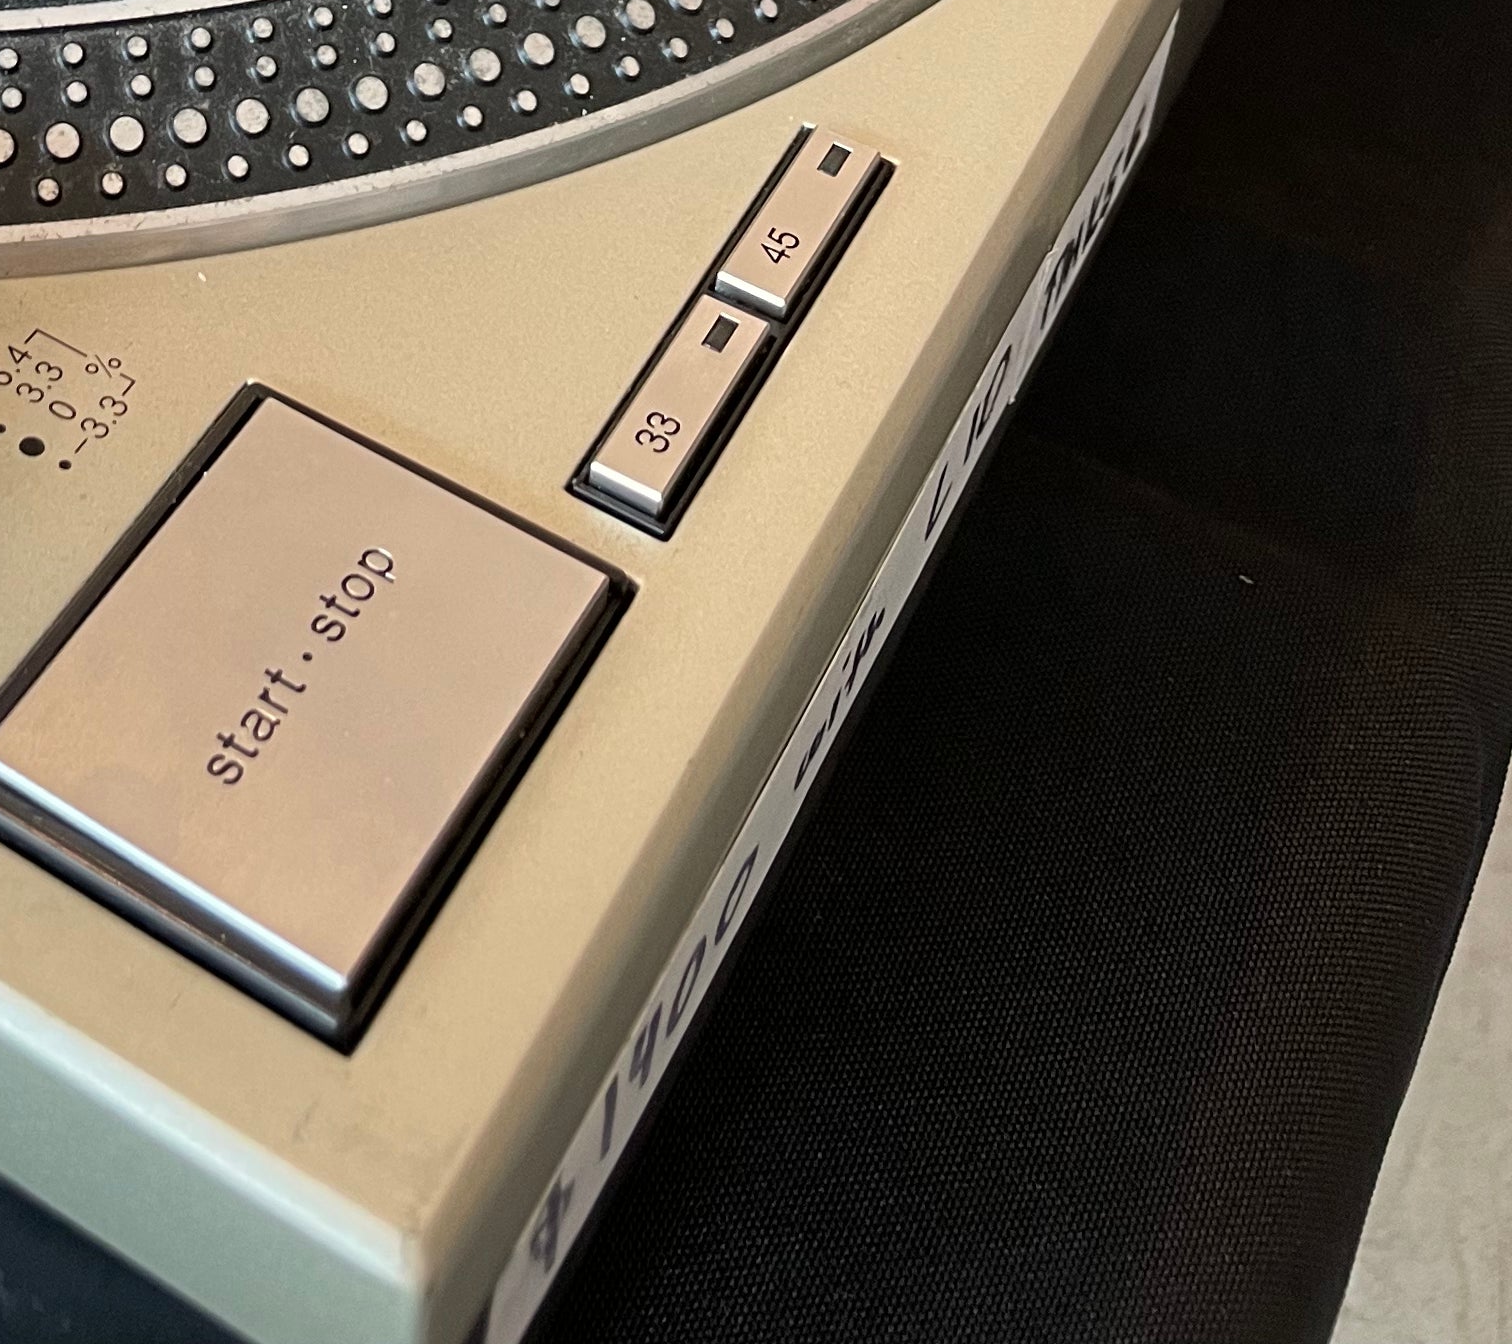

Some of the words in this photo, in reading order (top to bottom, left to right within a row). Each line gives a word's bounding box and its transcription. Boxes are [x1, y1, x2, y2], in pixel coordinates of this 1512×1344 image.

[760, 226, 801, 265] 45
[15, 360, 64, 404] 3.3
[48, 399, 77, 421] 0
[74, 394, 129, 455] -3.3
[634, 411, 682, 454] 33
